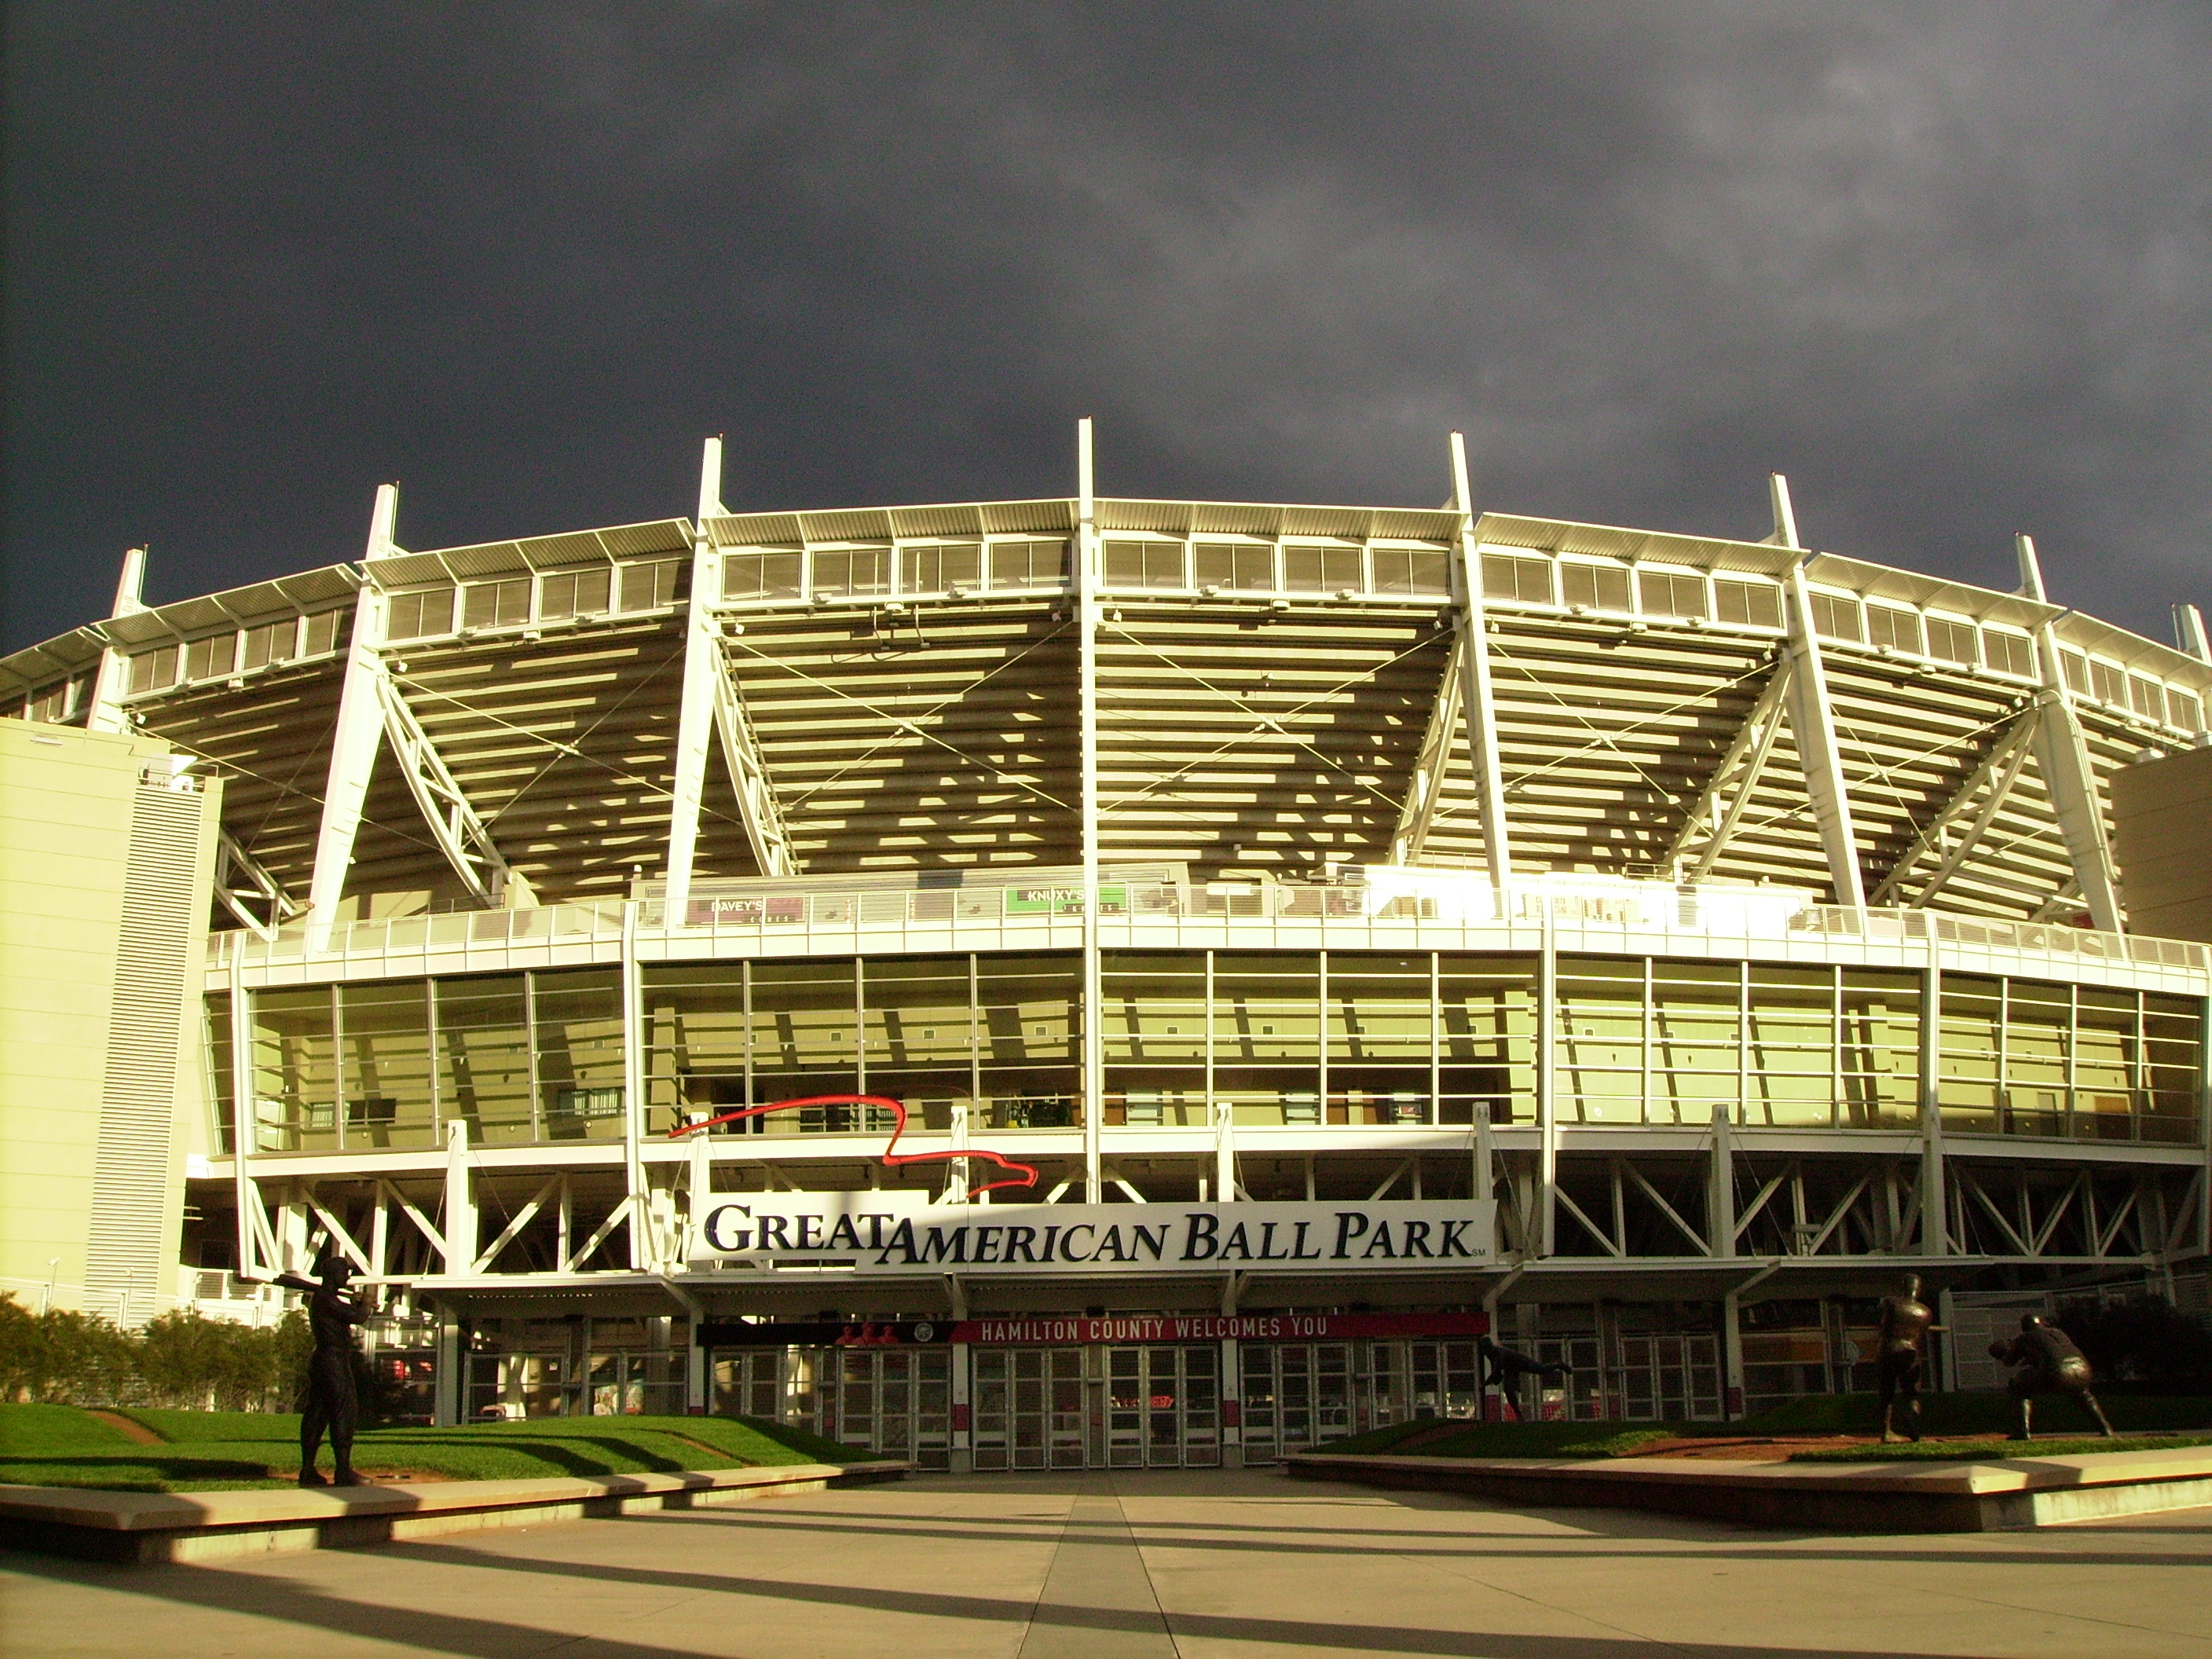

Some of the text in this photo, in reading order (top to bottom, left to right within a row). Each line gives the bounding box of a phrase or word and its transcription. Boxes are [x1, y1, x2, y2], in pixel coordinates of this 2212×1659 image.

[711, 900, 763, 912] DAVEY'S
[704, 1204, 895, 1252] GREAT
[874, 1217, 1171, 1265] AMERICAN
[1179, 1213, 1321, 1261] BALL
[1330, 1212, 1474, 1258] PARK
[982, 1317, 1328, 1341] HAMILTON COUNTY WELCOMES YOU
